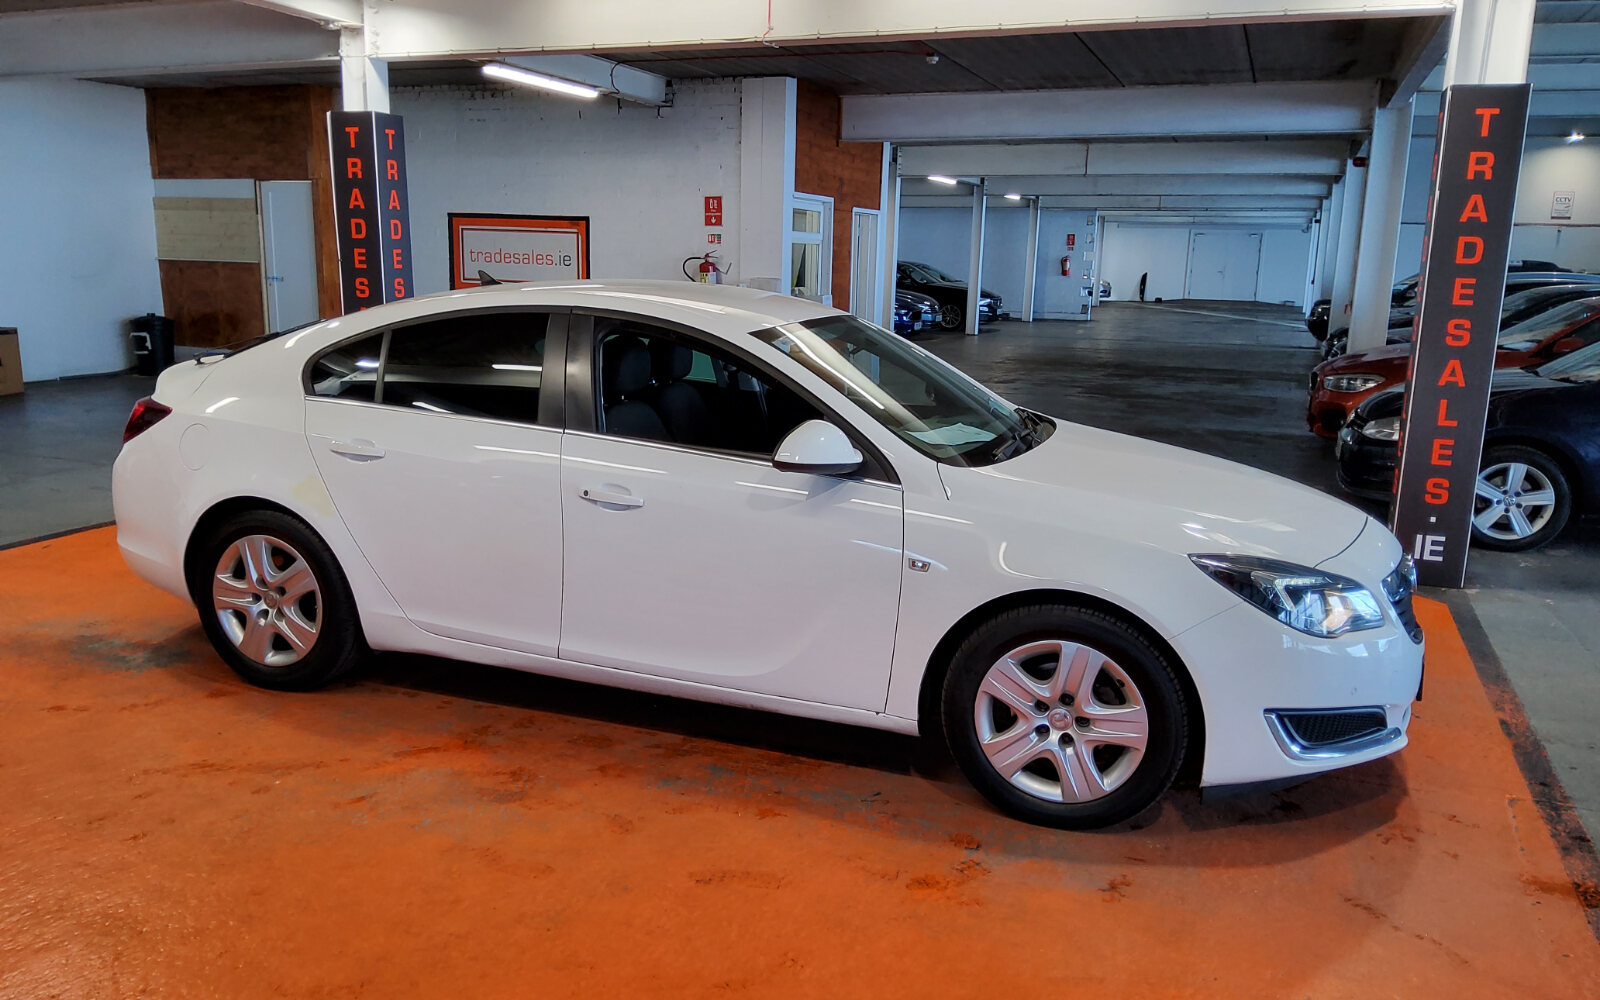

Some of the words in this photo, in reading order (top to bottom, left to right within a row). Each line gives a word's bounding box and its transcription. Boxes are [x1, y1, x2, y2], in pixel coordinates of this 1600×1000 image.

[345, 126, 370, 310] TRADES
[385, 128, 405, 298] TRADES
[469, 247, 572, 267] tradesales.ie
